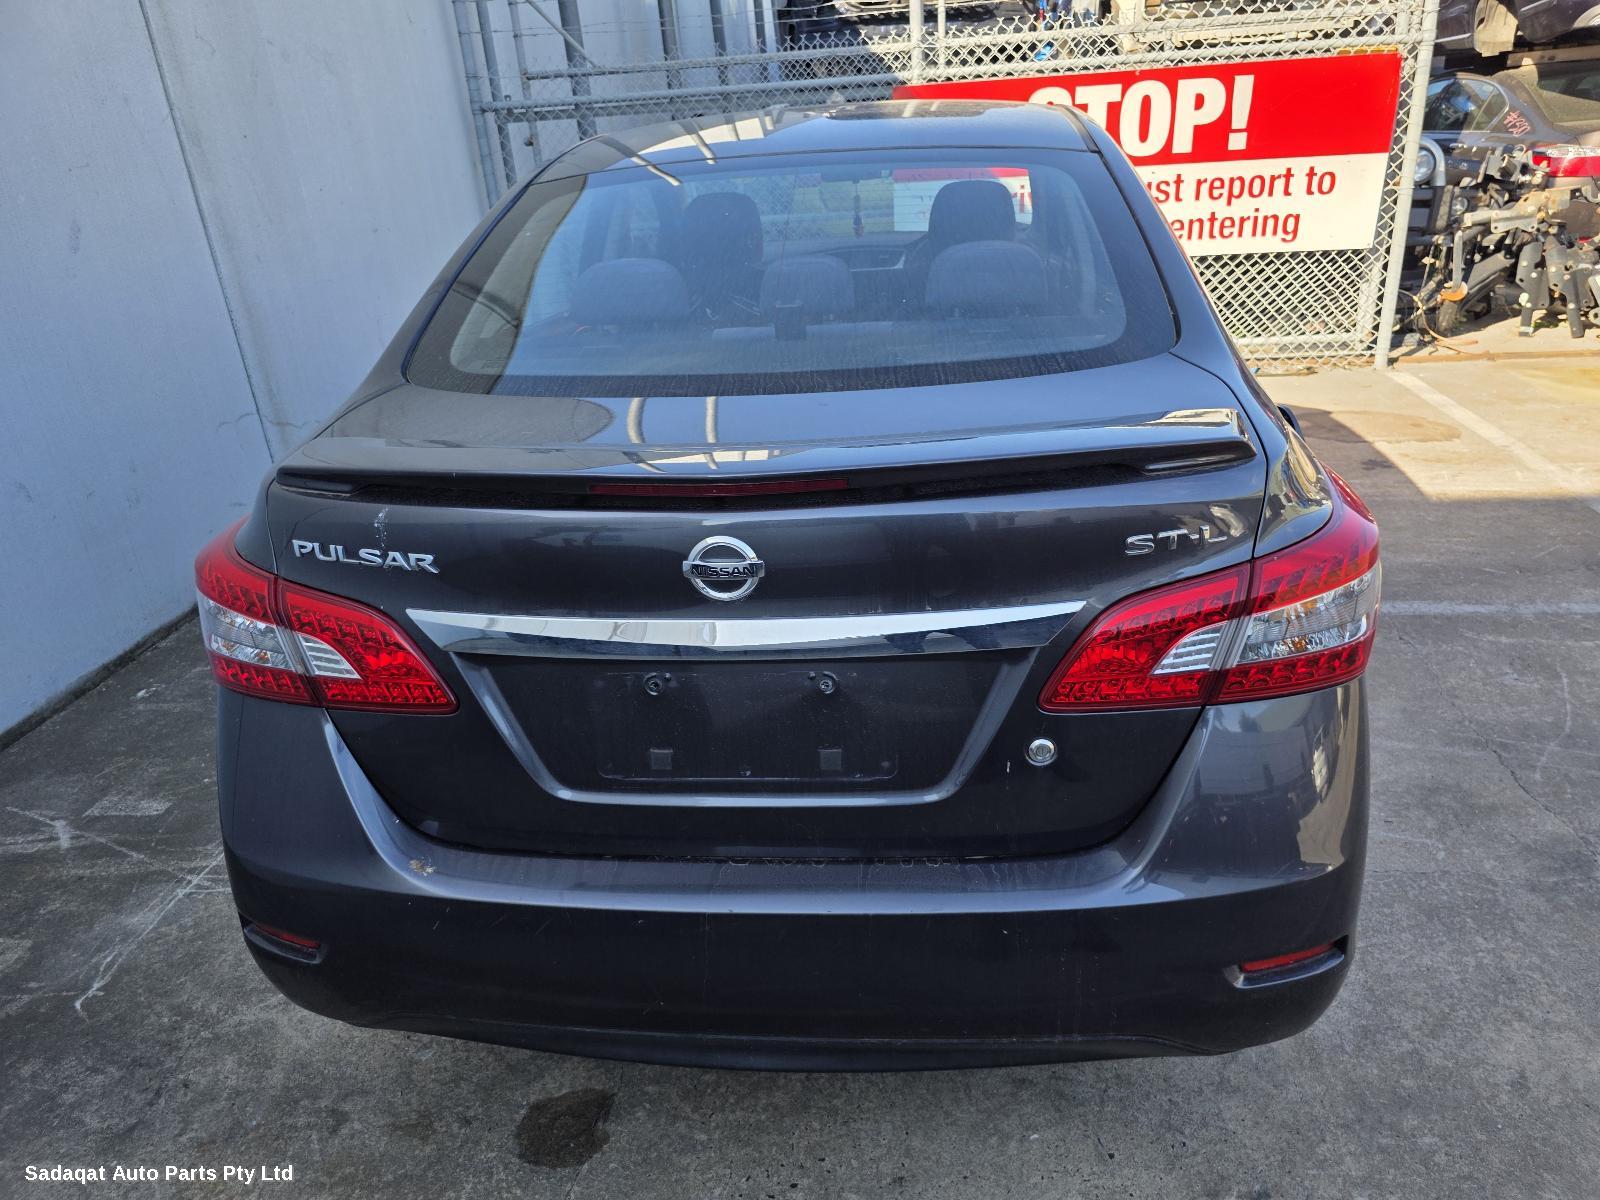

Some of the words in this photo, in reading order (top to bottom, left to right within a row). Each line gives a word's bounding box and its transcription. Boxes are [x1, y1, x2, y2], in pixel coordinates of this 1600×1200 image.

[1195, 167, 1294, 206] report
[1305, 166, 1336, 196] to
[1171, 207, 1301, 243] entering
[291, 539, 440, 574] PULSAR
[1124, 525, 1228, 555] ST-L
[691, 563, 756, 578] NISSAN
